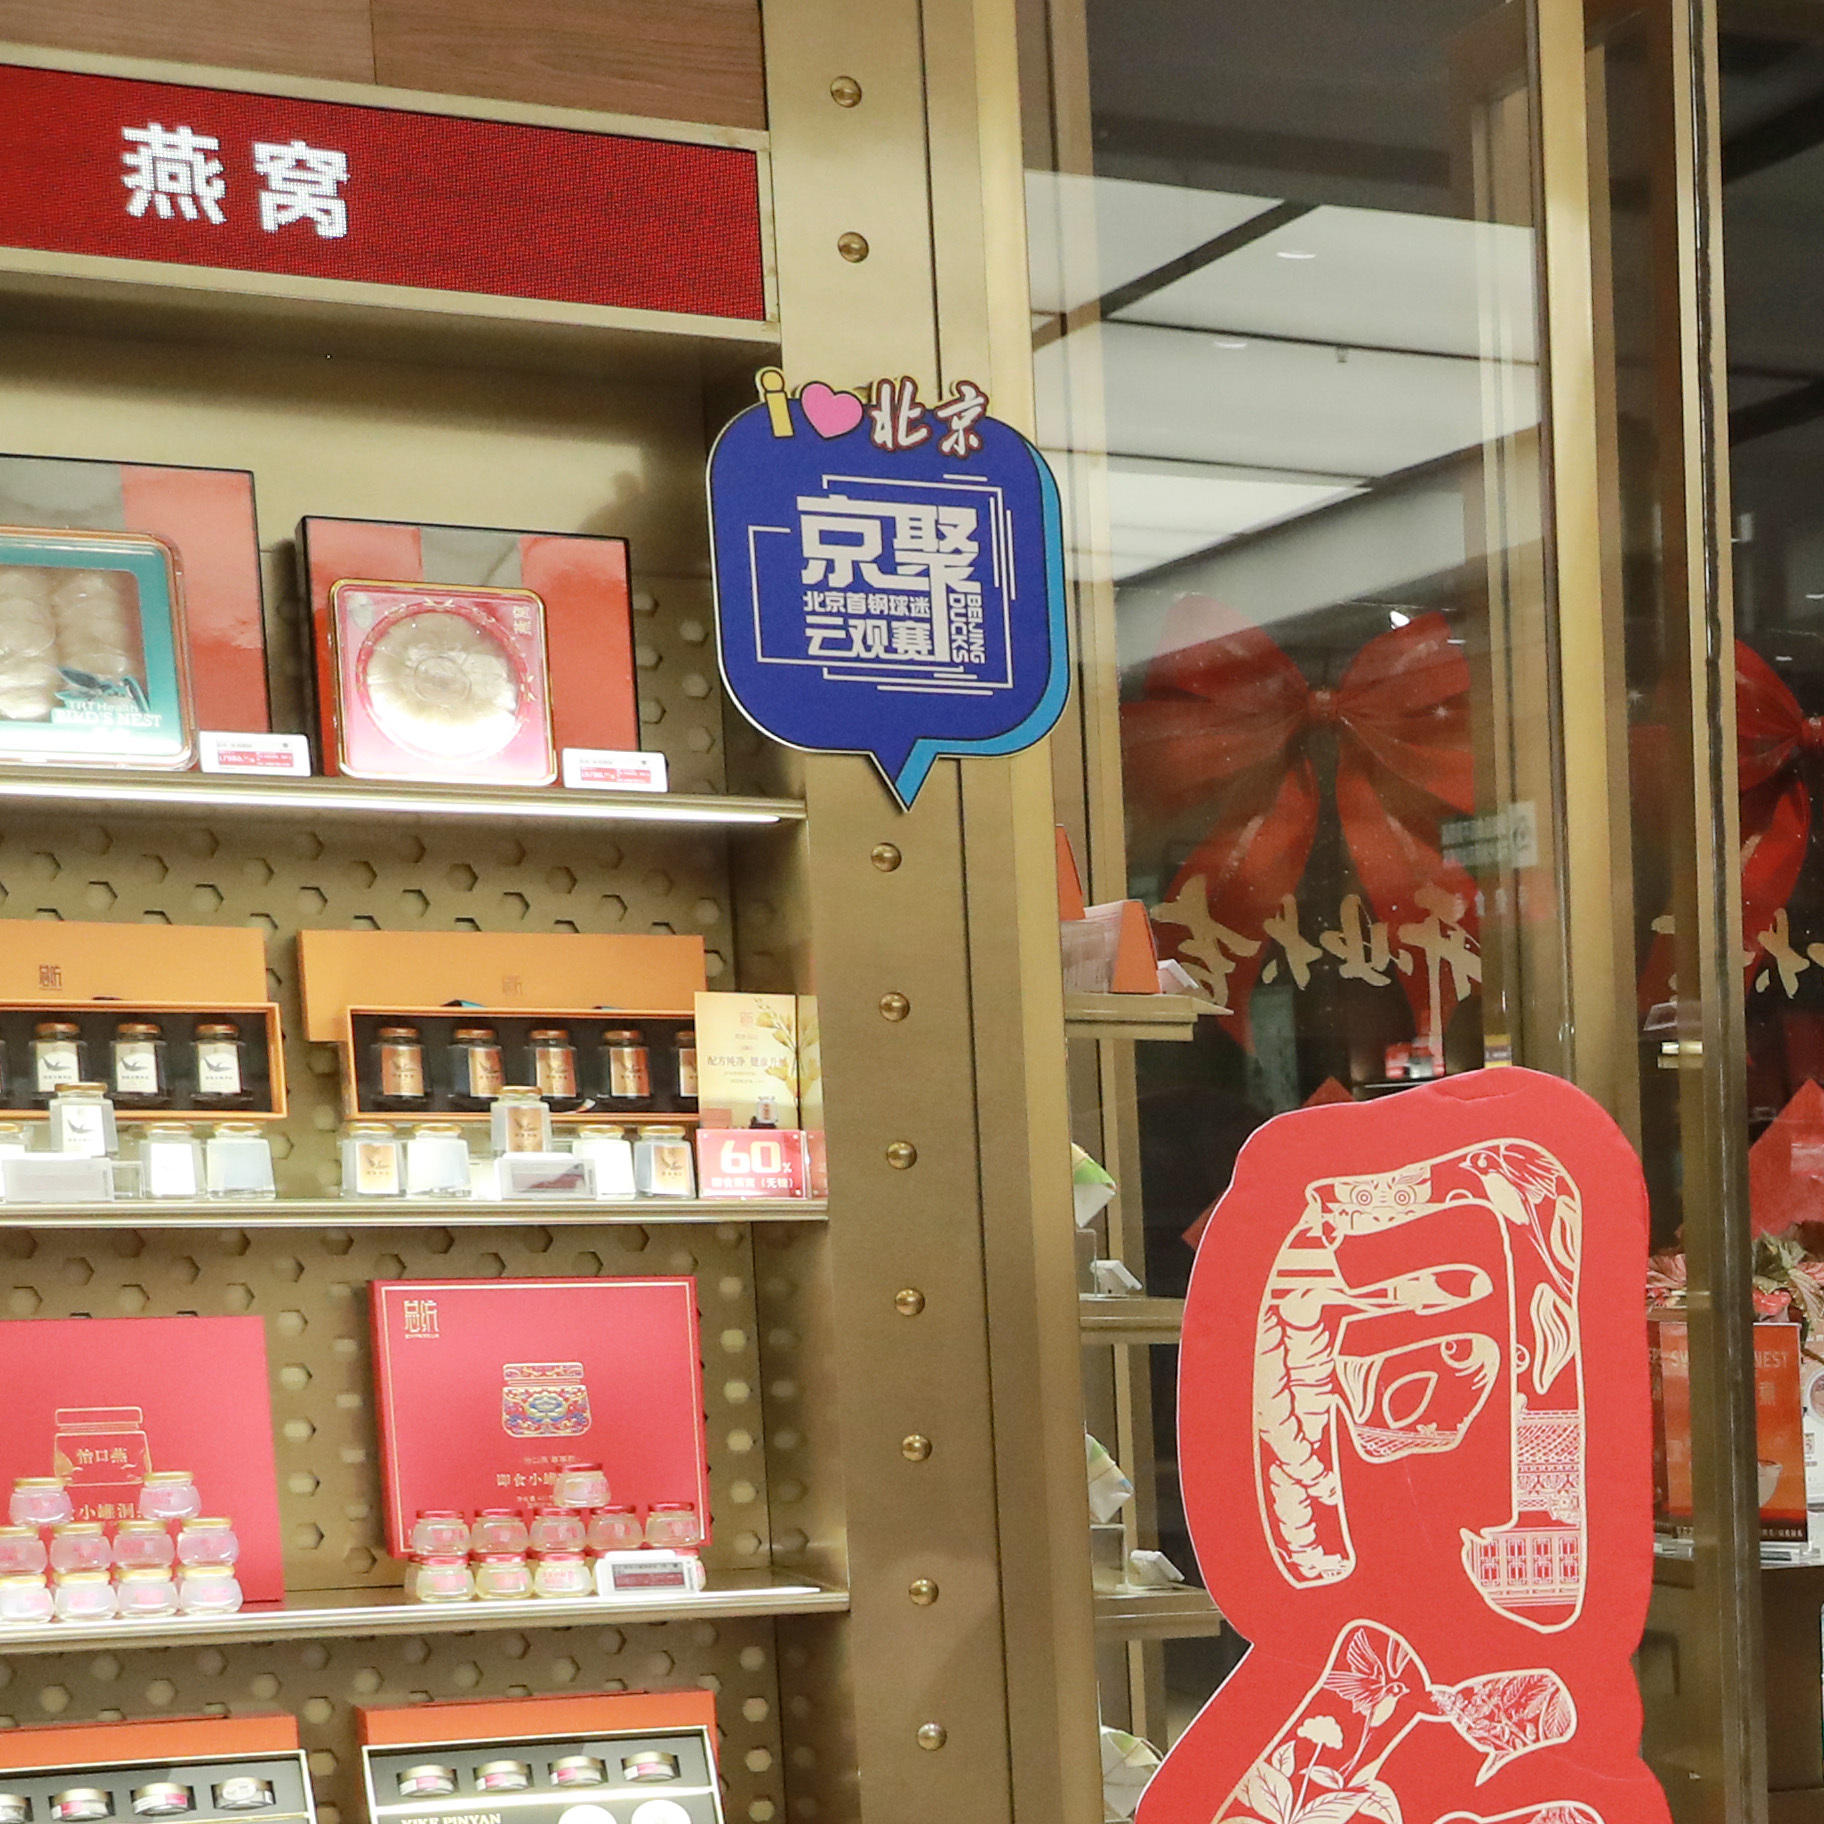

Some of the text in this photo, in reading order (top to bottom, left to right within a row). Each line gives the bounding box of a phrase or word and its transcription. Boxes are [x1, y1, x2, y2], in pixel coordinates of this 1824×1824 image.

[120, 121, 353, 240] 燕窝
[868, 376, 987, 457] 北京
[797, 494, 982, 661] 京聚
[803, 590, 931, 618] 北京首钢球迷
[805, 615, 936, 660] 云观赛
[949, 592, 970, 664] DUCKS
[967, 593, 986, 665] BEIJING
[117, 712, 162, 727] NEST
